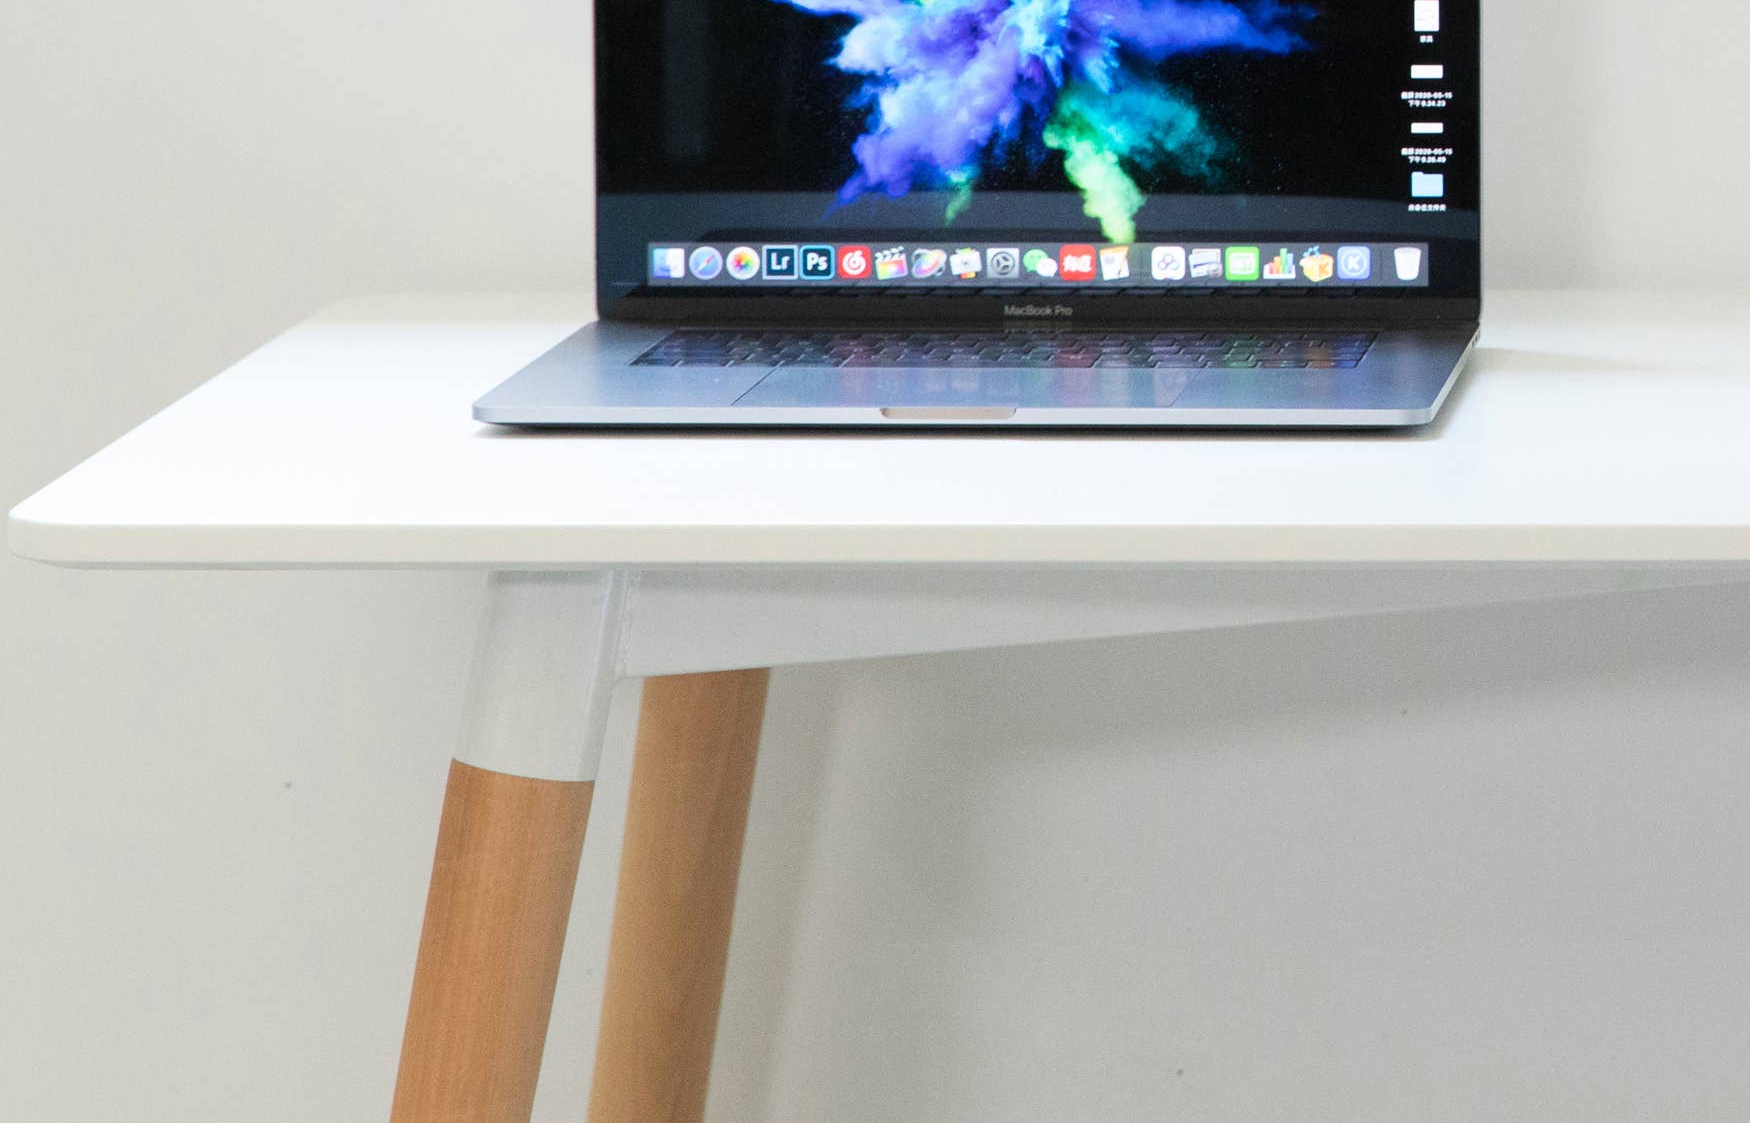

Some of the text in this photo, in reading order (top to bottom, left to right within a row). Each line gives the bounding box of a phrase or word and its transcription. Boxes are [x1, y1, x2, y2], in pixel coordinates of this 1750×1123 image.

[770, 252, 791, 271] Lr
[806, 251, 829, 271] Ps
[1004, 304, 1073, 316] MacBook Pro
